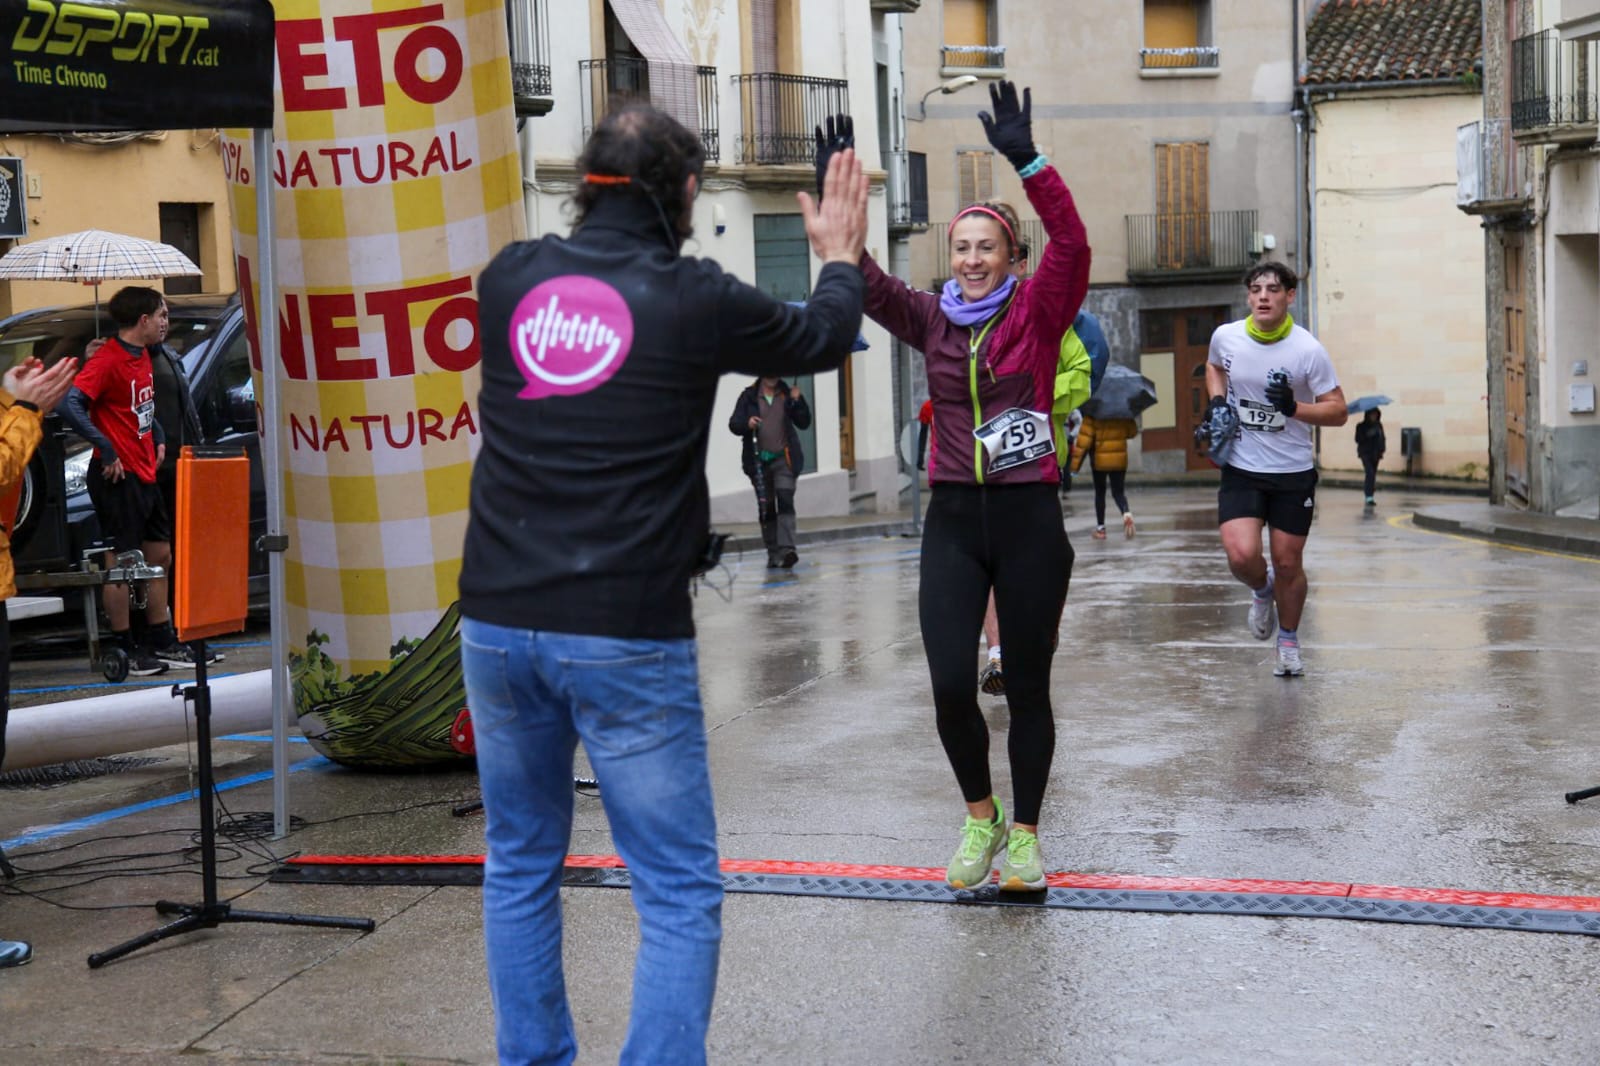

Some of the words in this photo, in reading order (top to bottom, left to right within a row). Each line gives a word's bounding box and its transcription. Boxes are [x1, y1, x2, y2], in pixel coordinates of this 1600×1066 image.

[13, 60, 52, 85] Time
[55, 65, 107, 89] Chrono
[275, 3, 463, 112] ETO
[238, 255, 481, 380] NETO
[290, 401, 477, 452] NATURA
[1000, 421, 1036, 450] 159
[1249, 410, 1275, 424] 197
